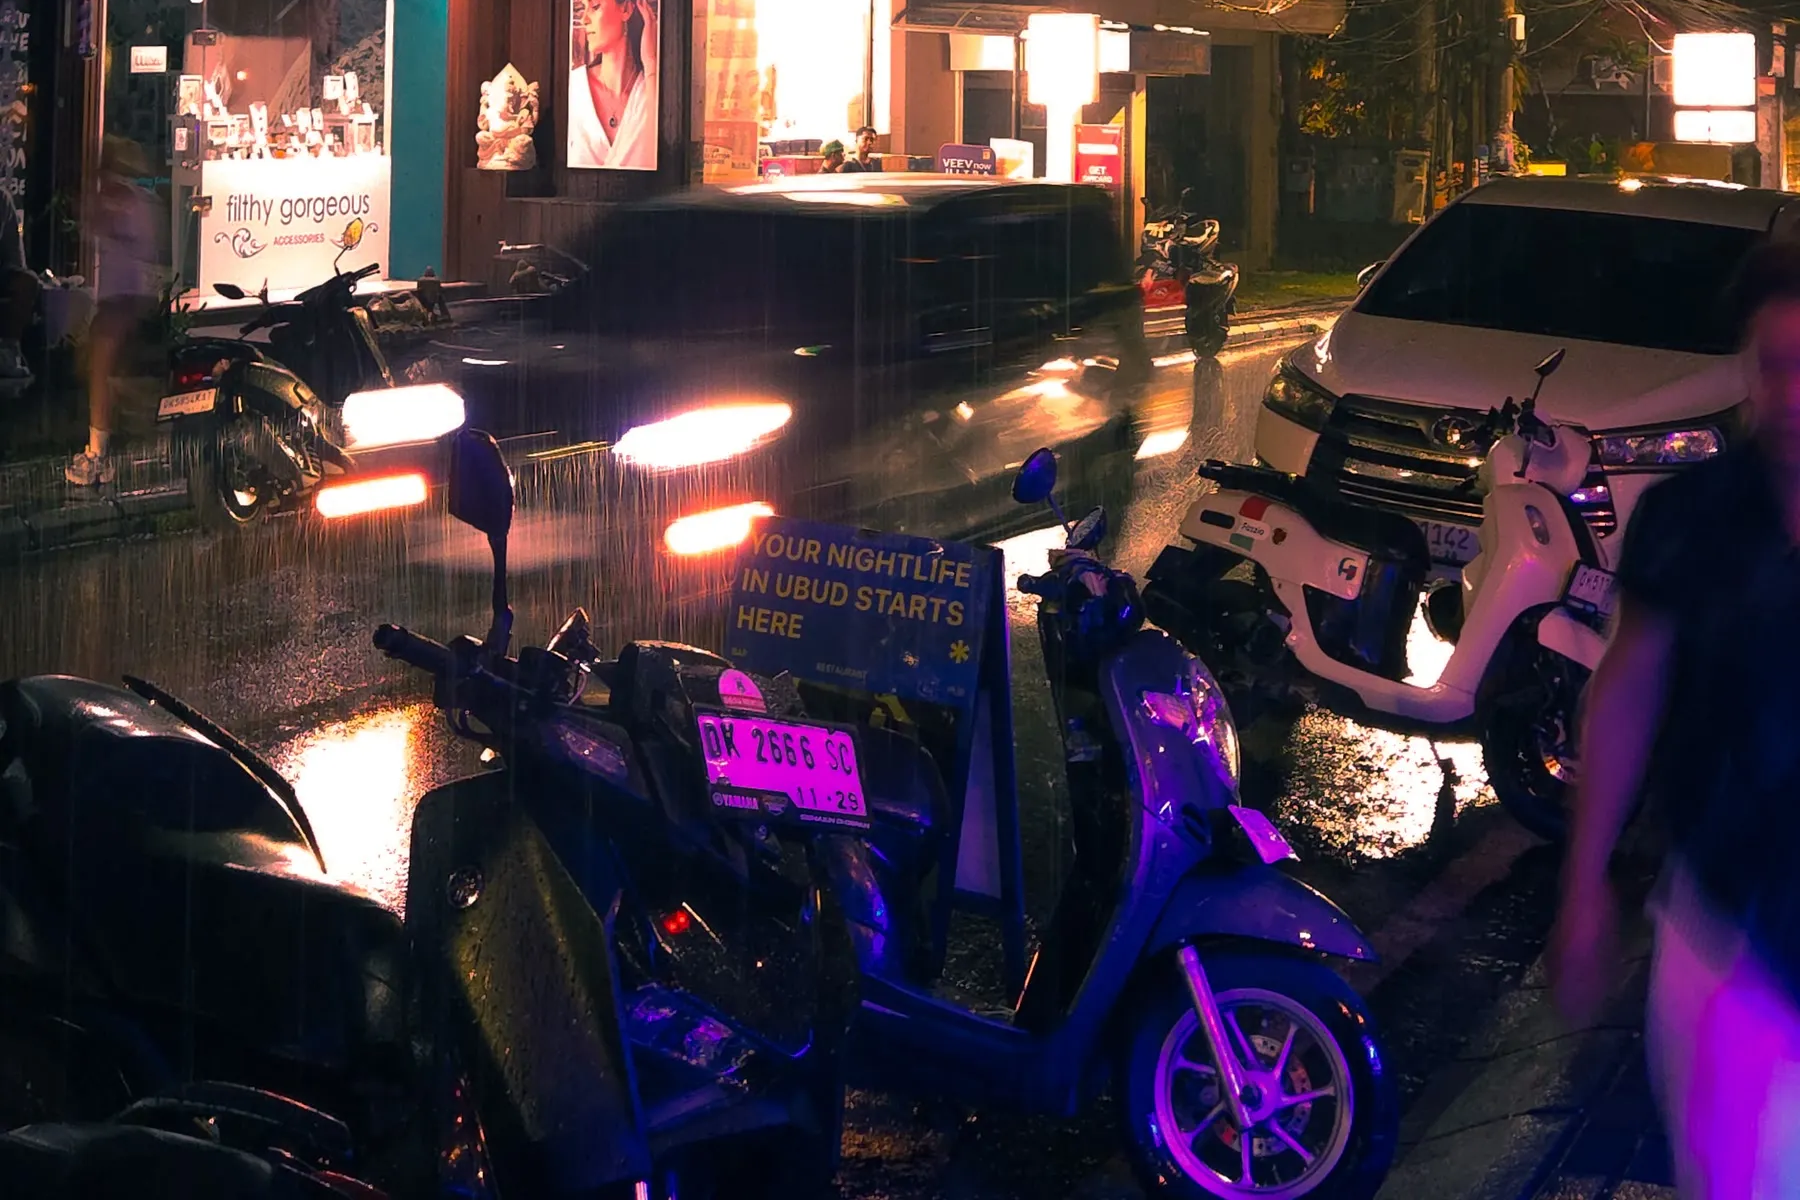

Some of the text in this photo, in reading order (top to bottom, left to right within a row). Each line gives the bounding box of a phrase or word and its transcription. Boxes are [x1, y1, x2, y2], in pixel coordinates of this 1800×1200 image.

[942, 158, 992, 170] VEEV now
[226, 194, 370, 226] filthy gorgeous
[273, 232, 325, 246] ACCESSORIES
[751, 533, 973, 588] YOUR NIGHTLIFE
[742, 567, 965, 626] IN UBUD STARTS
[737, 604, 804, 639] HERE
[703, 721, 853, 775] DK 2666 SC
